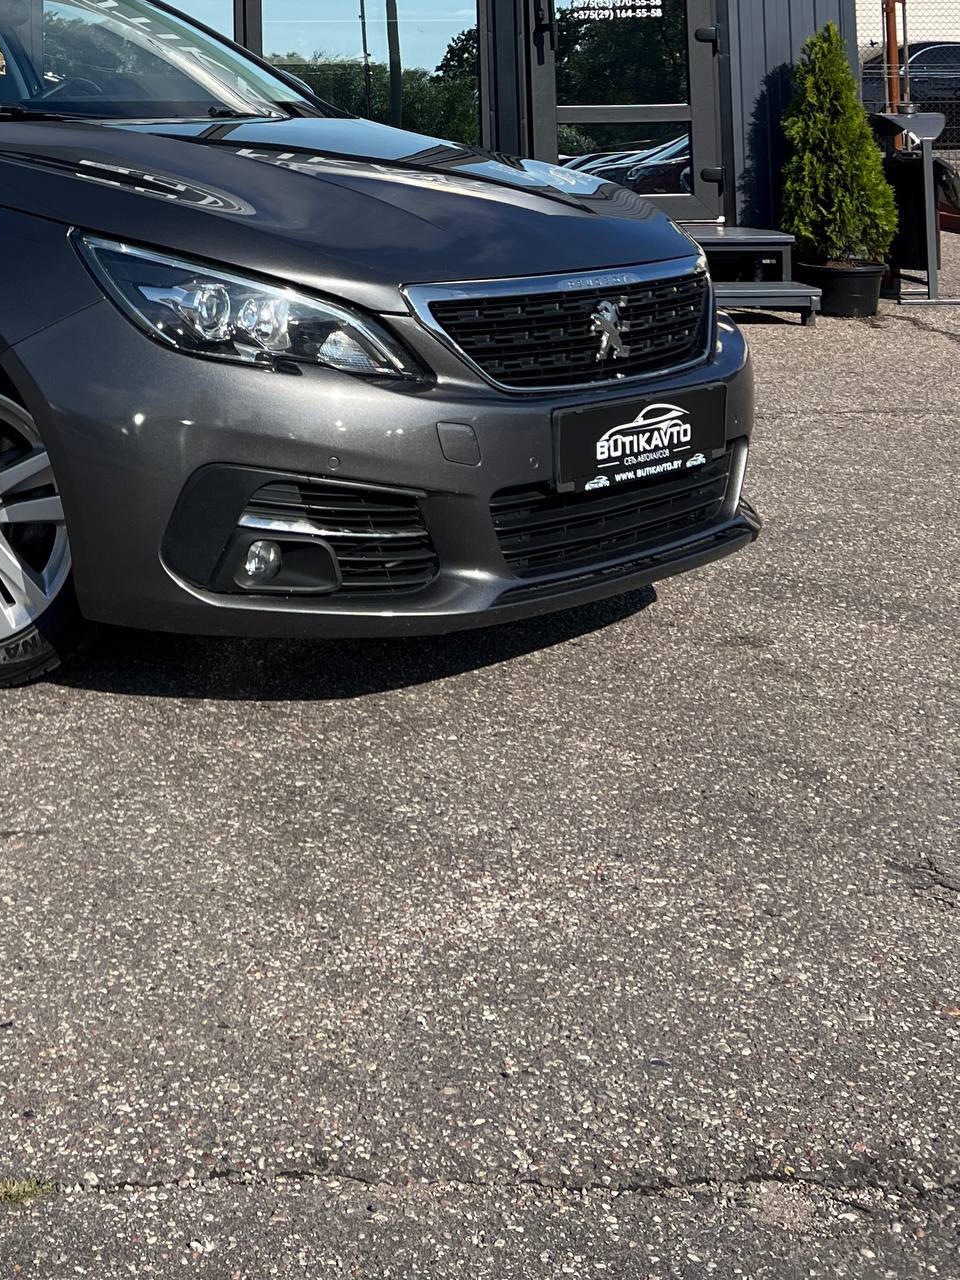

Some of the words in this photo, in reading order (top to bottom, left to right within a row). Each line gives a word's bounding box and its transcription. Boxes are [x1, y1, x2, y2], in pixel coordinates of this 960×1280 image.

[573, 0, 613, 9] +375(33)
[573, 9, 614, 20] +375(29)
[615, 8, 663, 18] 164-55-58
[596, 423, 691, 461] BUTIKAVTO
[636, 459, 682, 478] BUTIKAVTO.BY
